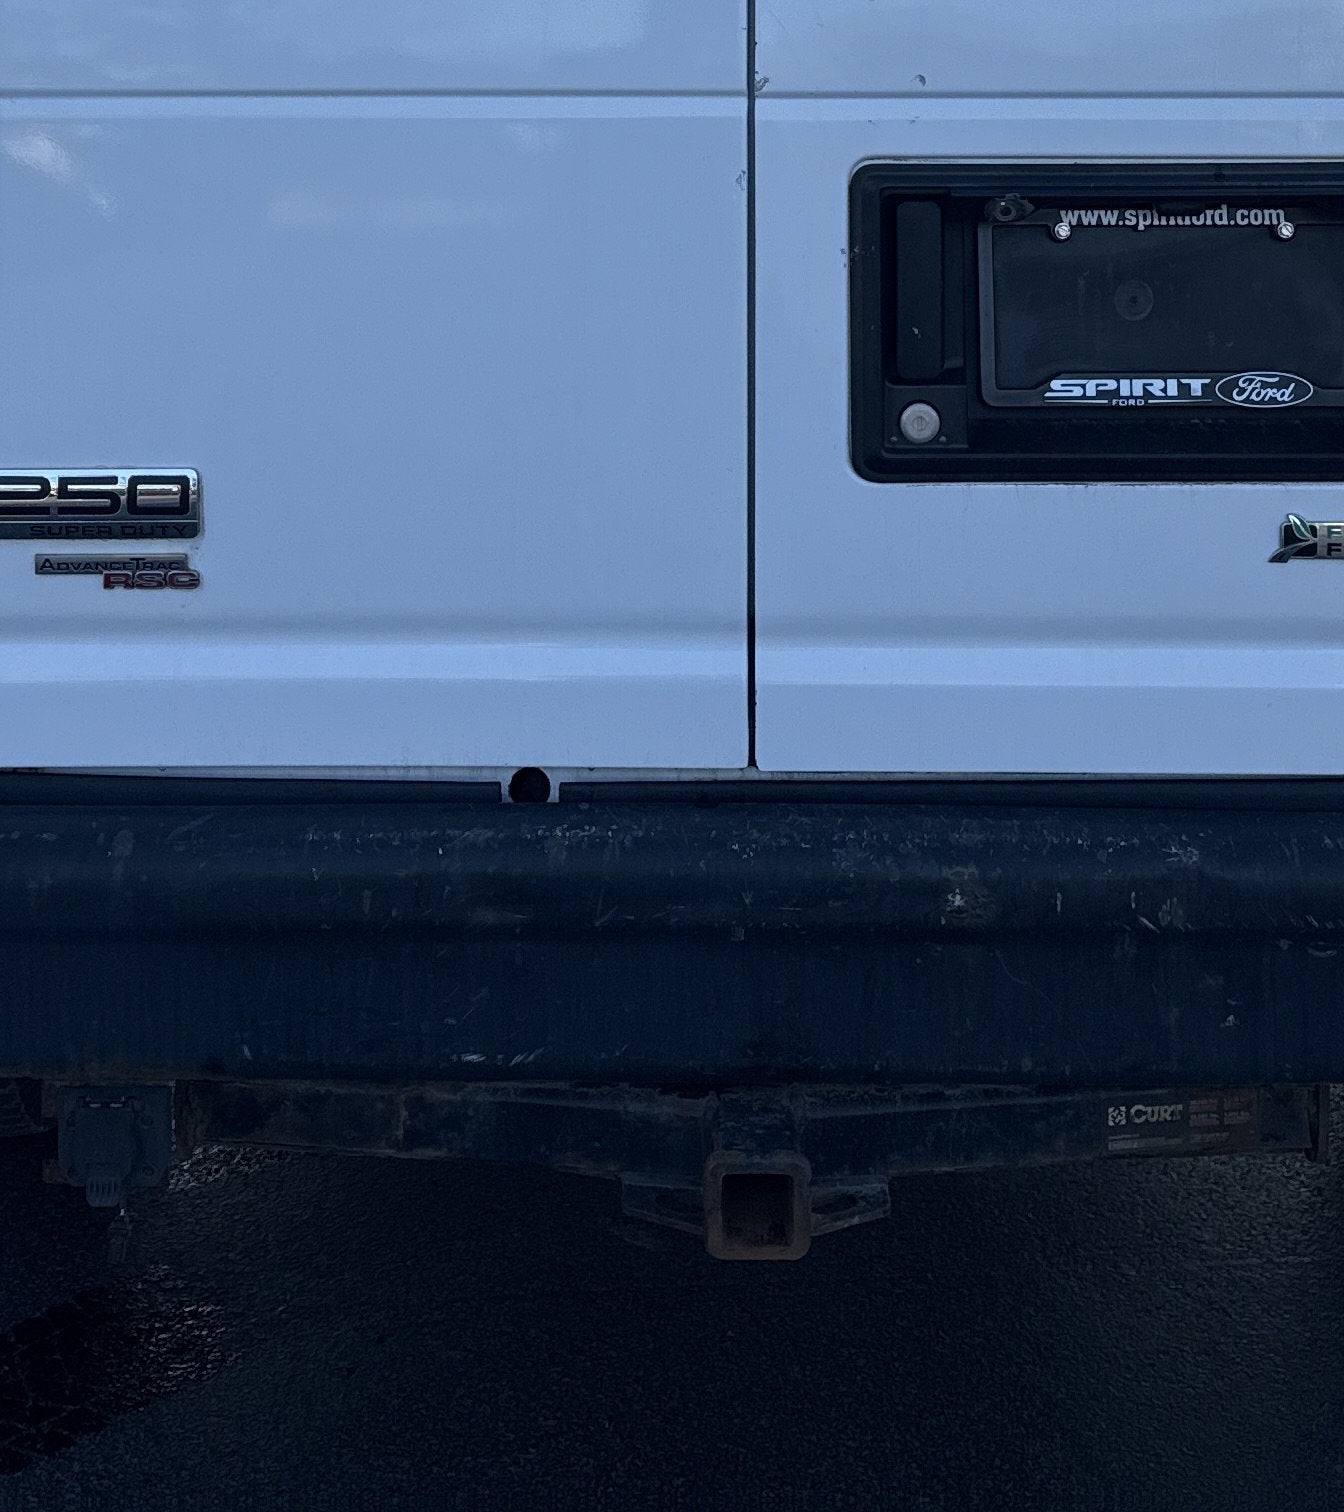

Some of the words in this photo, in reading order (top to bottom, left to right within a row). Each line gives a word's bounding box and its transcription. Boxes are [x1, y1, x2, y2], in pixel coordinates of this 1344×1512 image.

[1043, 378, 1212, 397] SPIRIT
[1232, 375, 1295, 402] Ford
[1111, 398, 1145, 406] FORD
[29, 524, 113, 537] SUPER
[119, 524, 189, 537] DUTY
[102, 571, 201, 590] RSC
[1129, 1103, 1184, 1124] CURT
